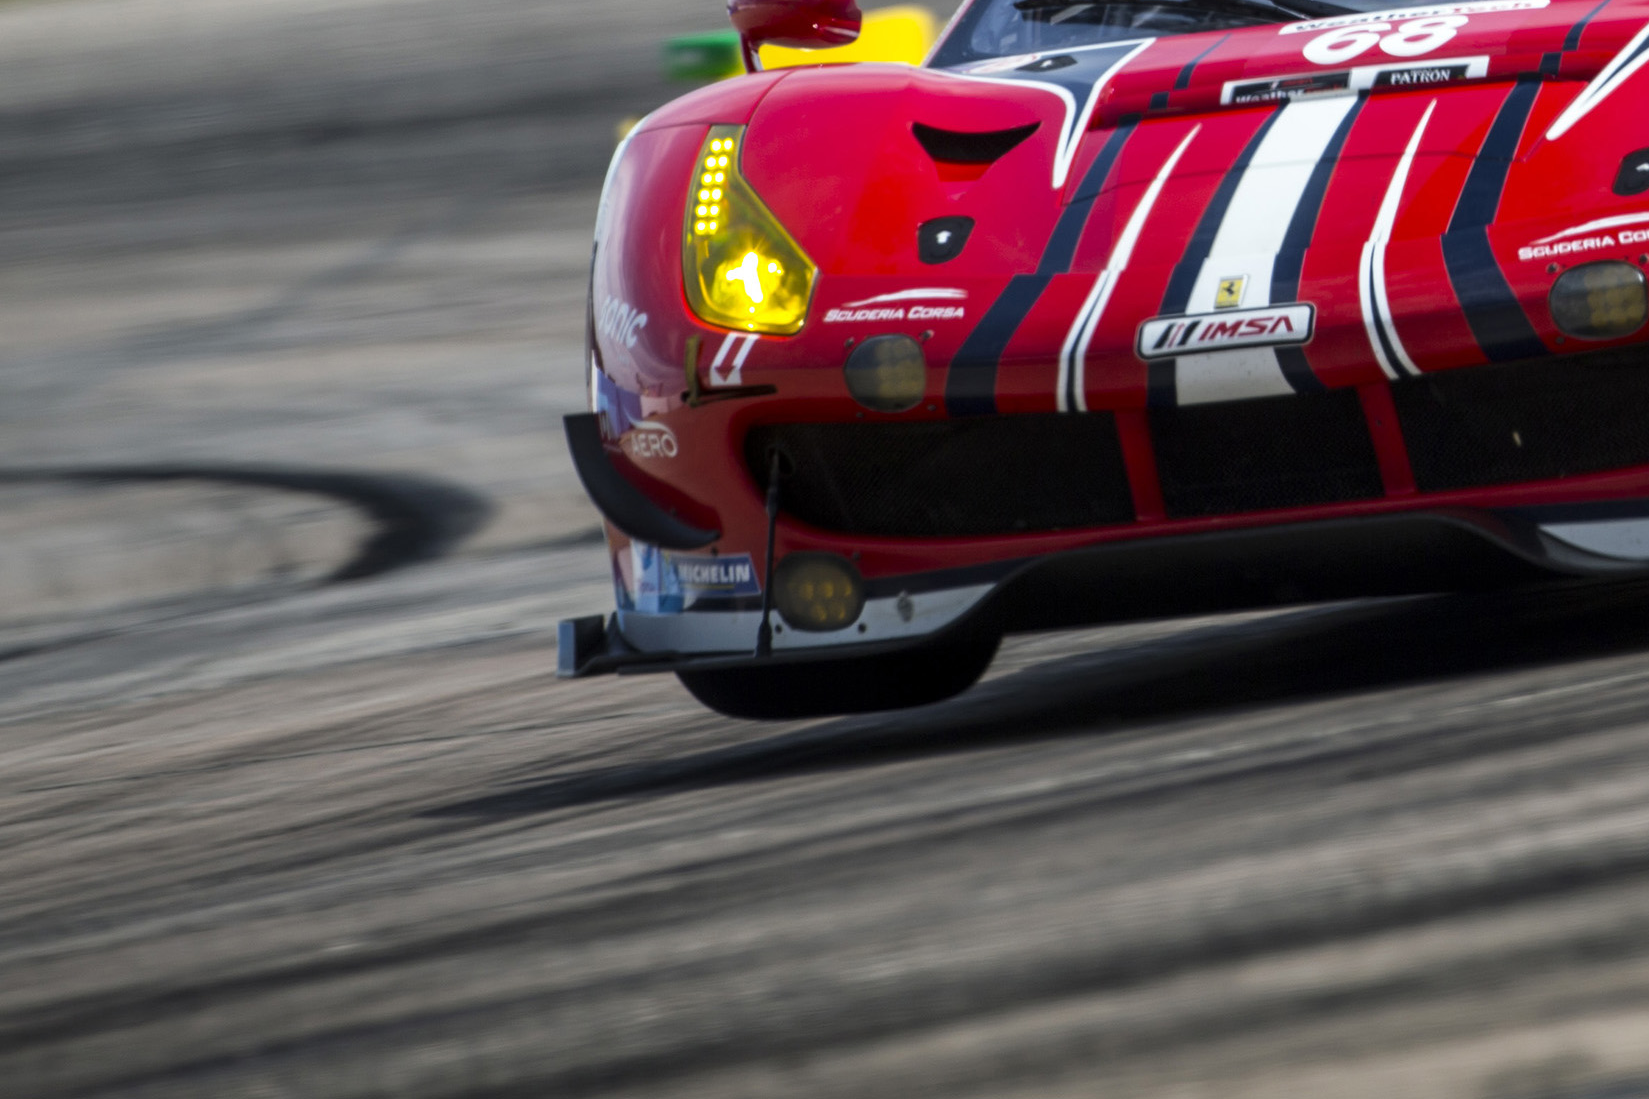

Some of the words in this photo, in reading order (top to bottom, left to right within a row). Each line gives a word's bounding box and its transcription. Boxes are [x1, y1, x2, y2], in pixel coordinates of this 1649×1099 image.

[1302, 15, 1469, 65] 68
[1518, 235, 1615, 260] SCUDERIA
[824, 308, 905, 322] SCUDERIA
[907, 306, 965, 319] CORSA
[631, 433, 678, 458] AERO
[678, 563, 751, 585] MICHELIN
